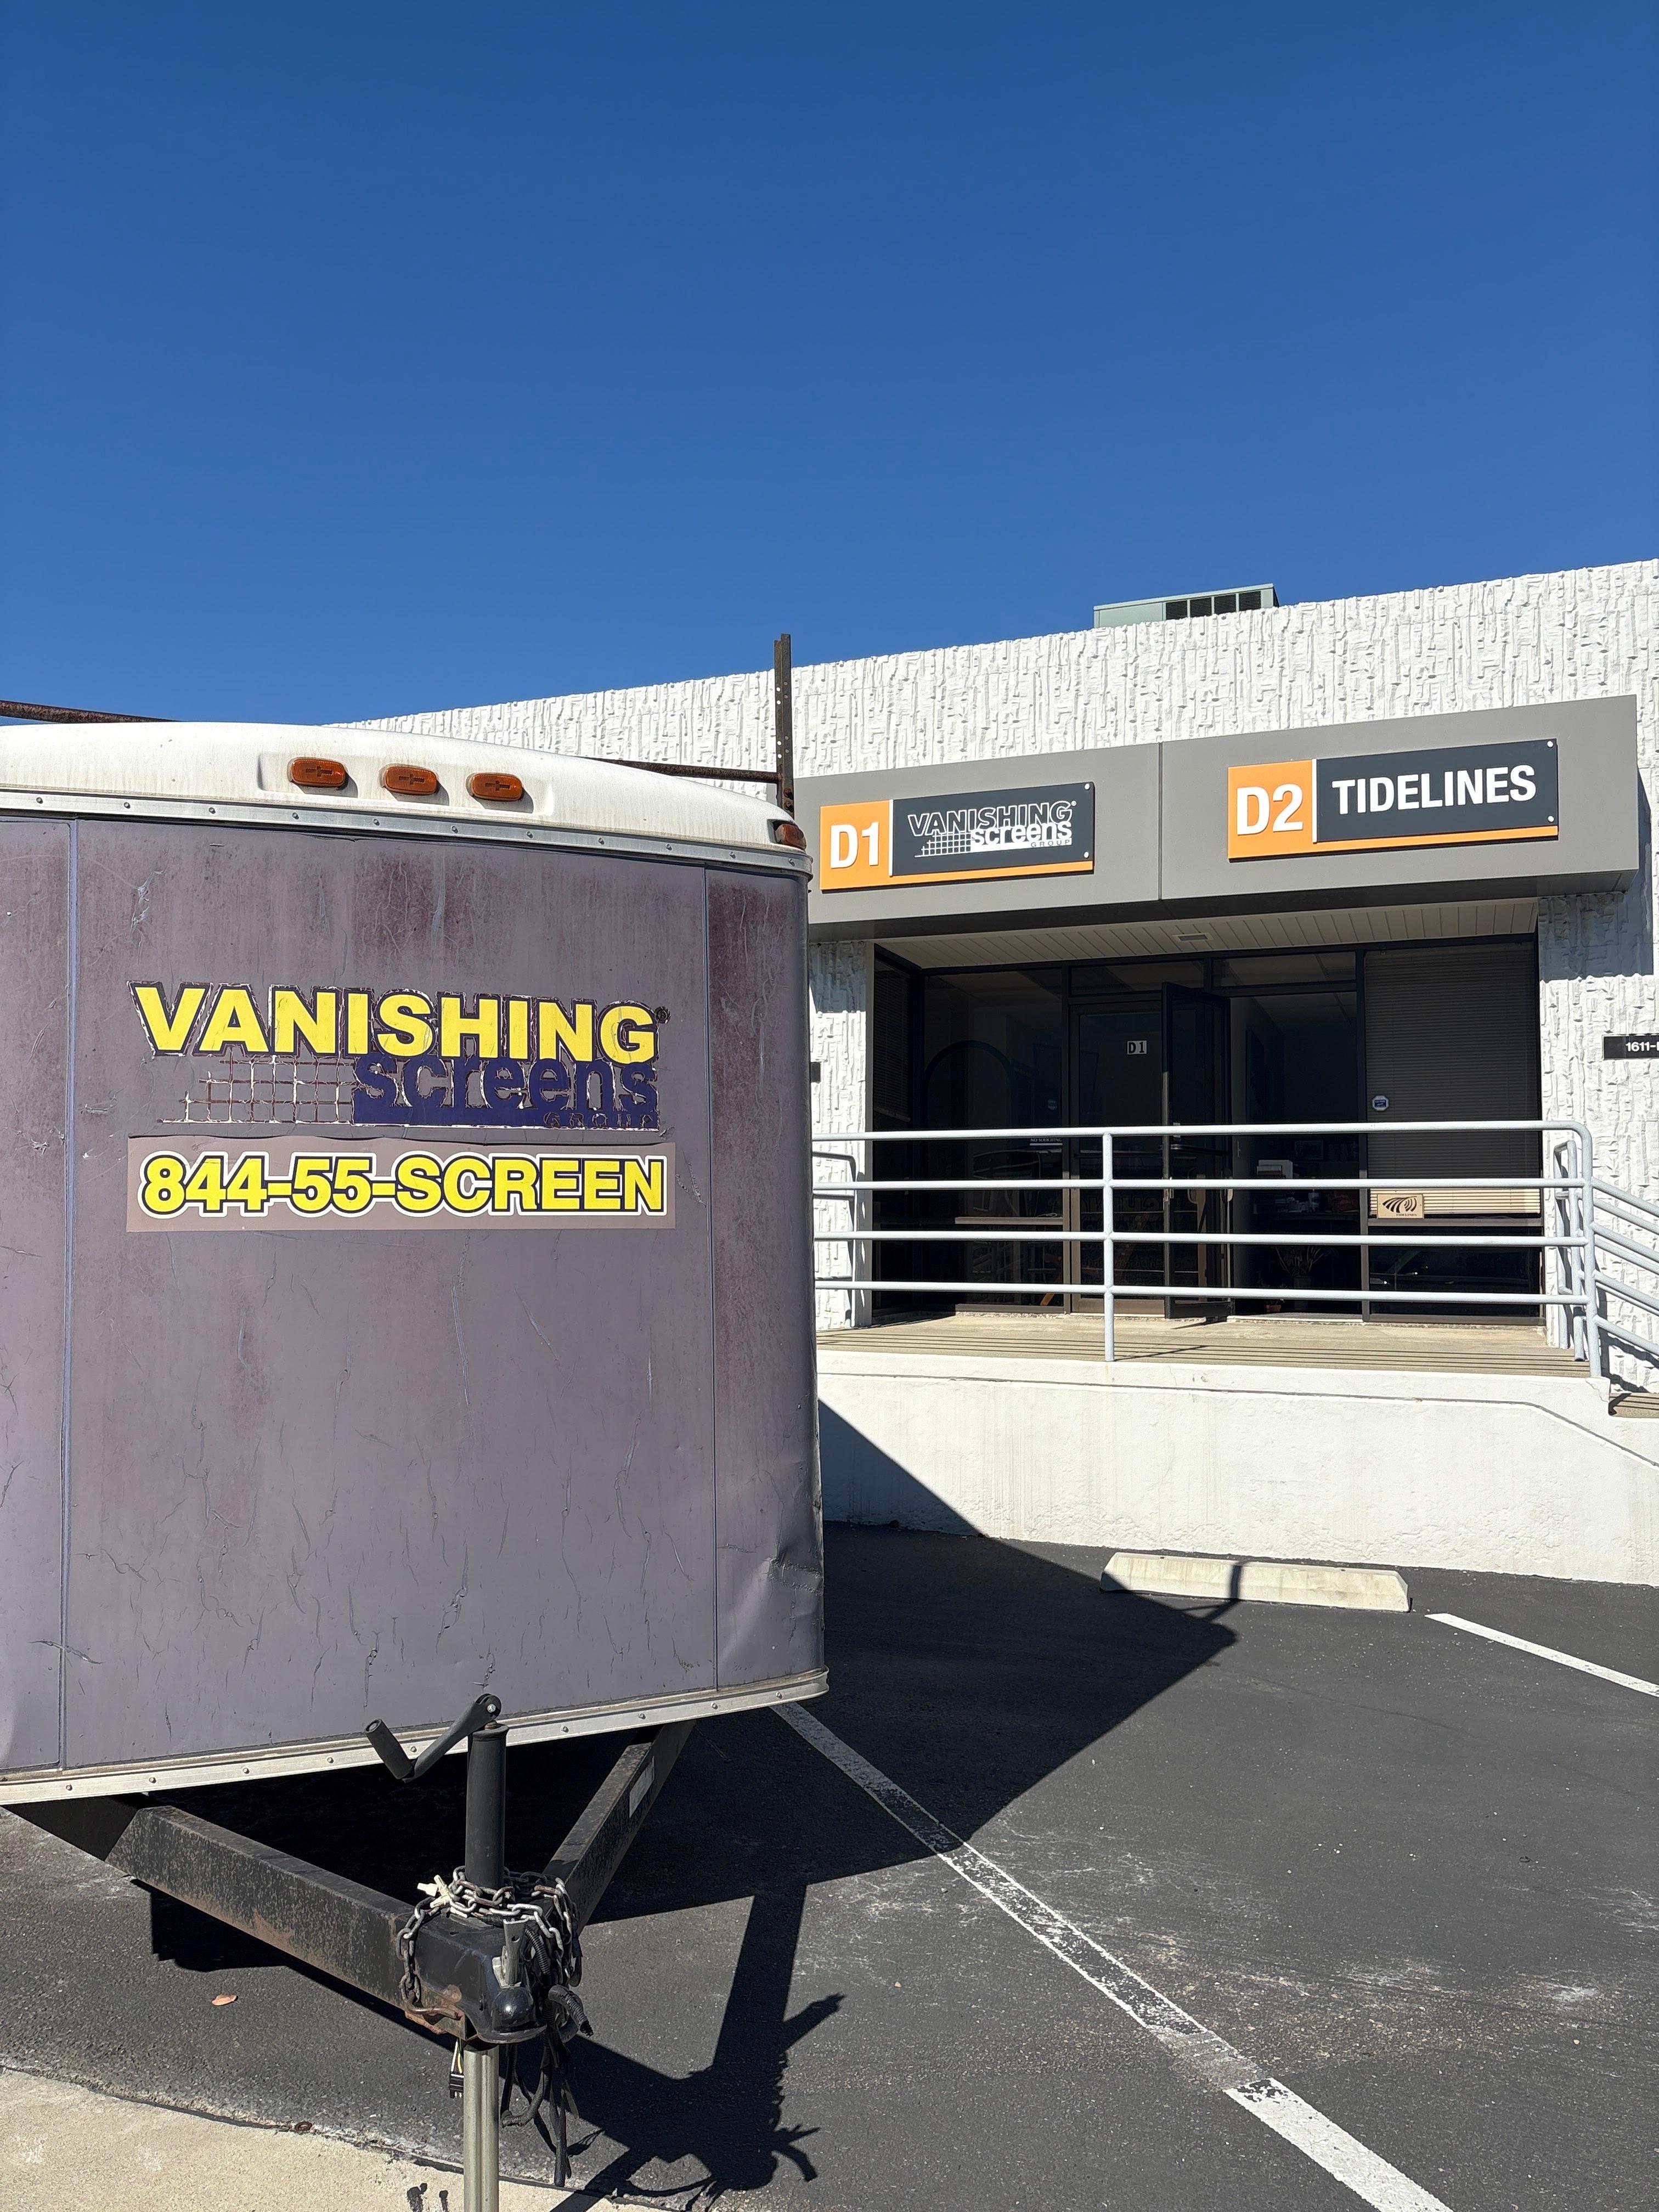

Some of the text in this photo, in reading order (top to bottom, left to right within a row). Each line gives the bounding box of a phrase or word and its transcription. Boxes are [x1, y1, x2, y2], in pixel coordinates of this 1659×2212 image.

[1236, 783, 1304, 836] D2
[1331, 764, 1537, 815] TIDELINES
[830, 821, 880, 868] D1
[970, 821, 1072, 847] screens
[1030, 839, 1070, 848] GROUP
[354, 1054, 658, 1110] screens
[543, 1111, 653, 1128] GROUP
[142, 1153, 665, 1215] 844-55-SCREEN
